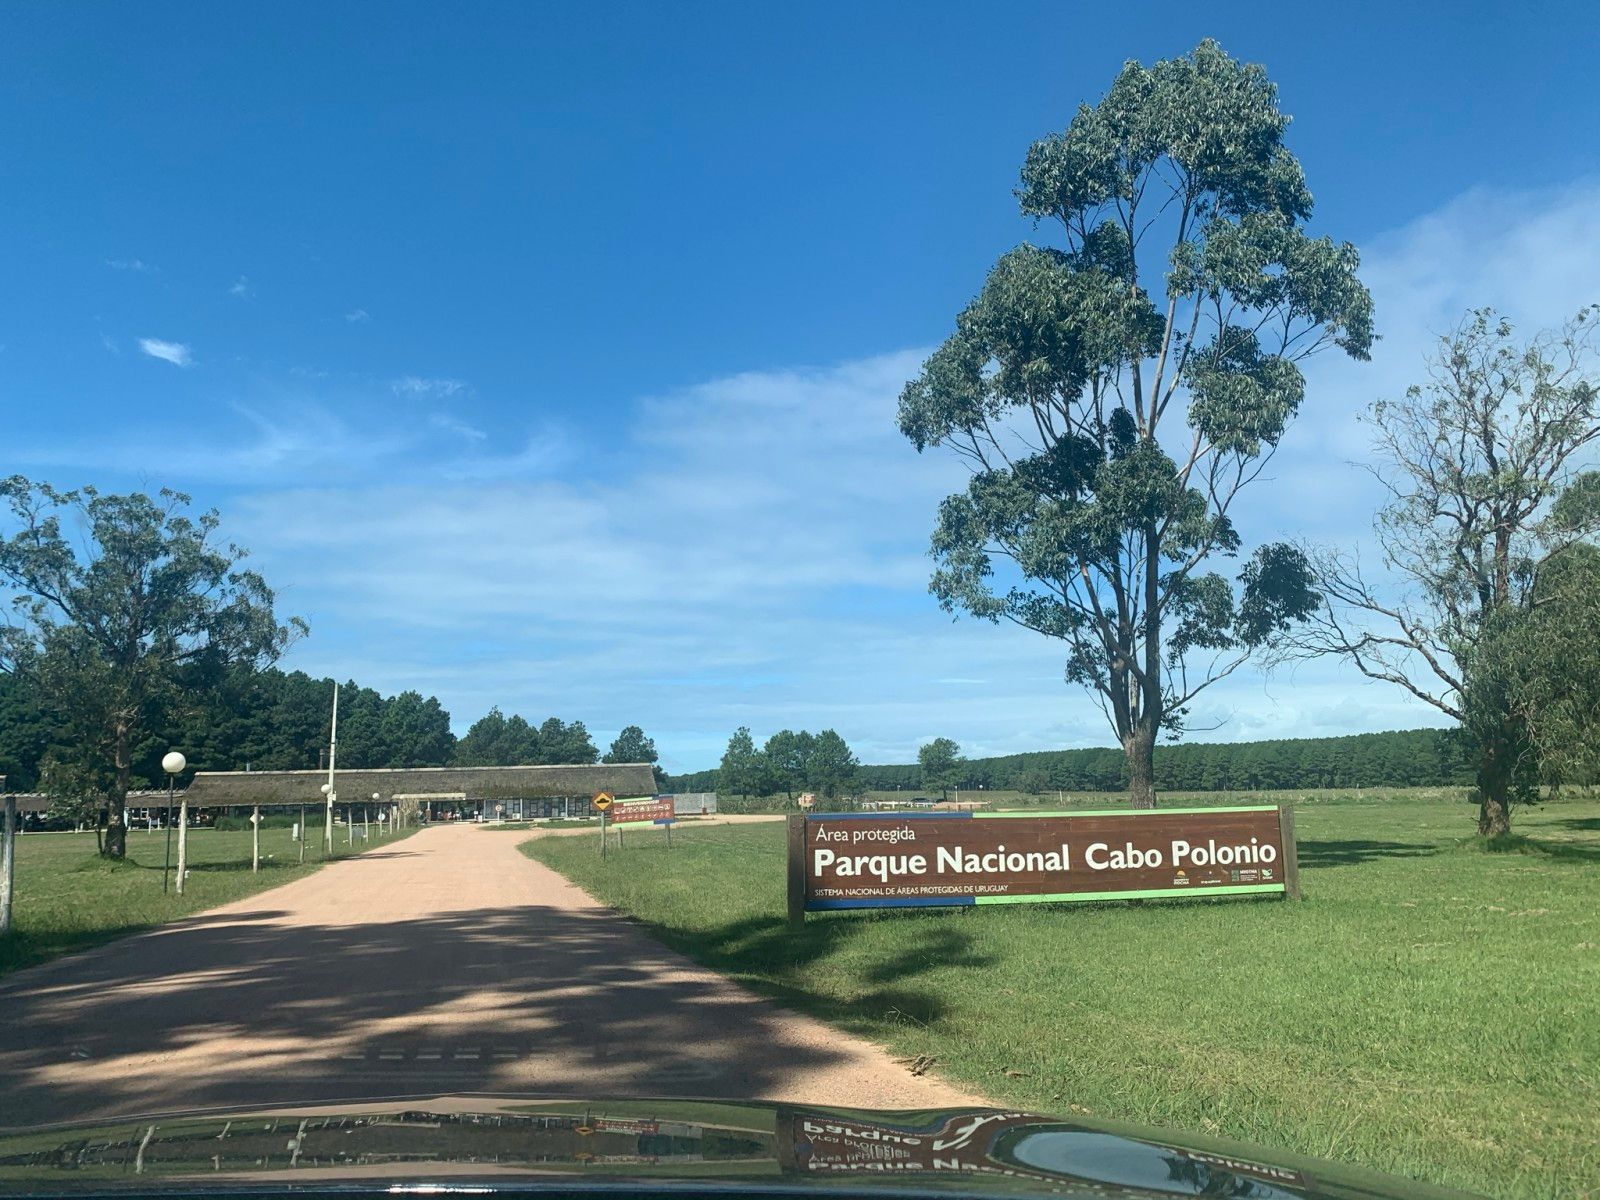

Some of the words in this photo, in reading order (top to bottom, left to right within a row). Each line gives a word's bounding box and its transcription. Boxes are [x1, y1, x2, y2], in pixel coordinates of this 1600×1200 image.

[815, 823, 849, 842] Área
[853, 825, 916, 845] protegida
[814, 848, 927, 883] Parque
[936, 844, 1070, 874] Nacional
[1084, 841, 1163, 870] Cabo
[1171, 837, 1277, 867] Polonio
[814, 888, 844, 896] SISTEMA
[845, 888, 884, 896] NACIONAL
[885, 887, 895, 895] DE
[896, 886, 919, 895] ÁREAS
[920, 886, 963, 894] PROTEGIDAS
[963, 885, 974, 893] DE
[974, 884, 1009, 893] URUGUAY
